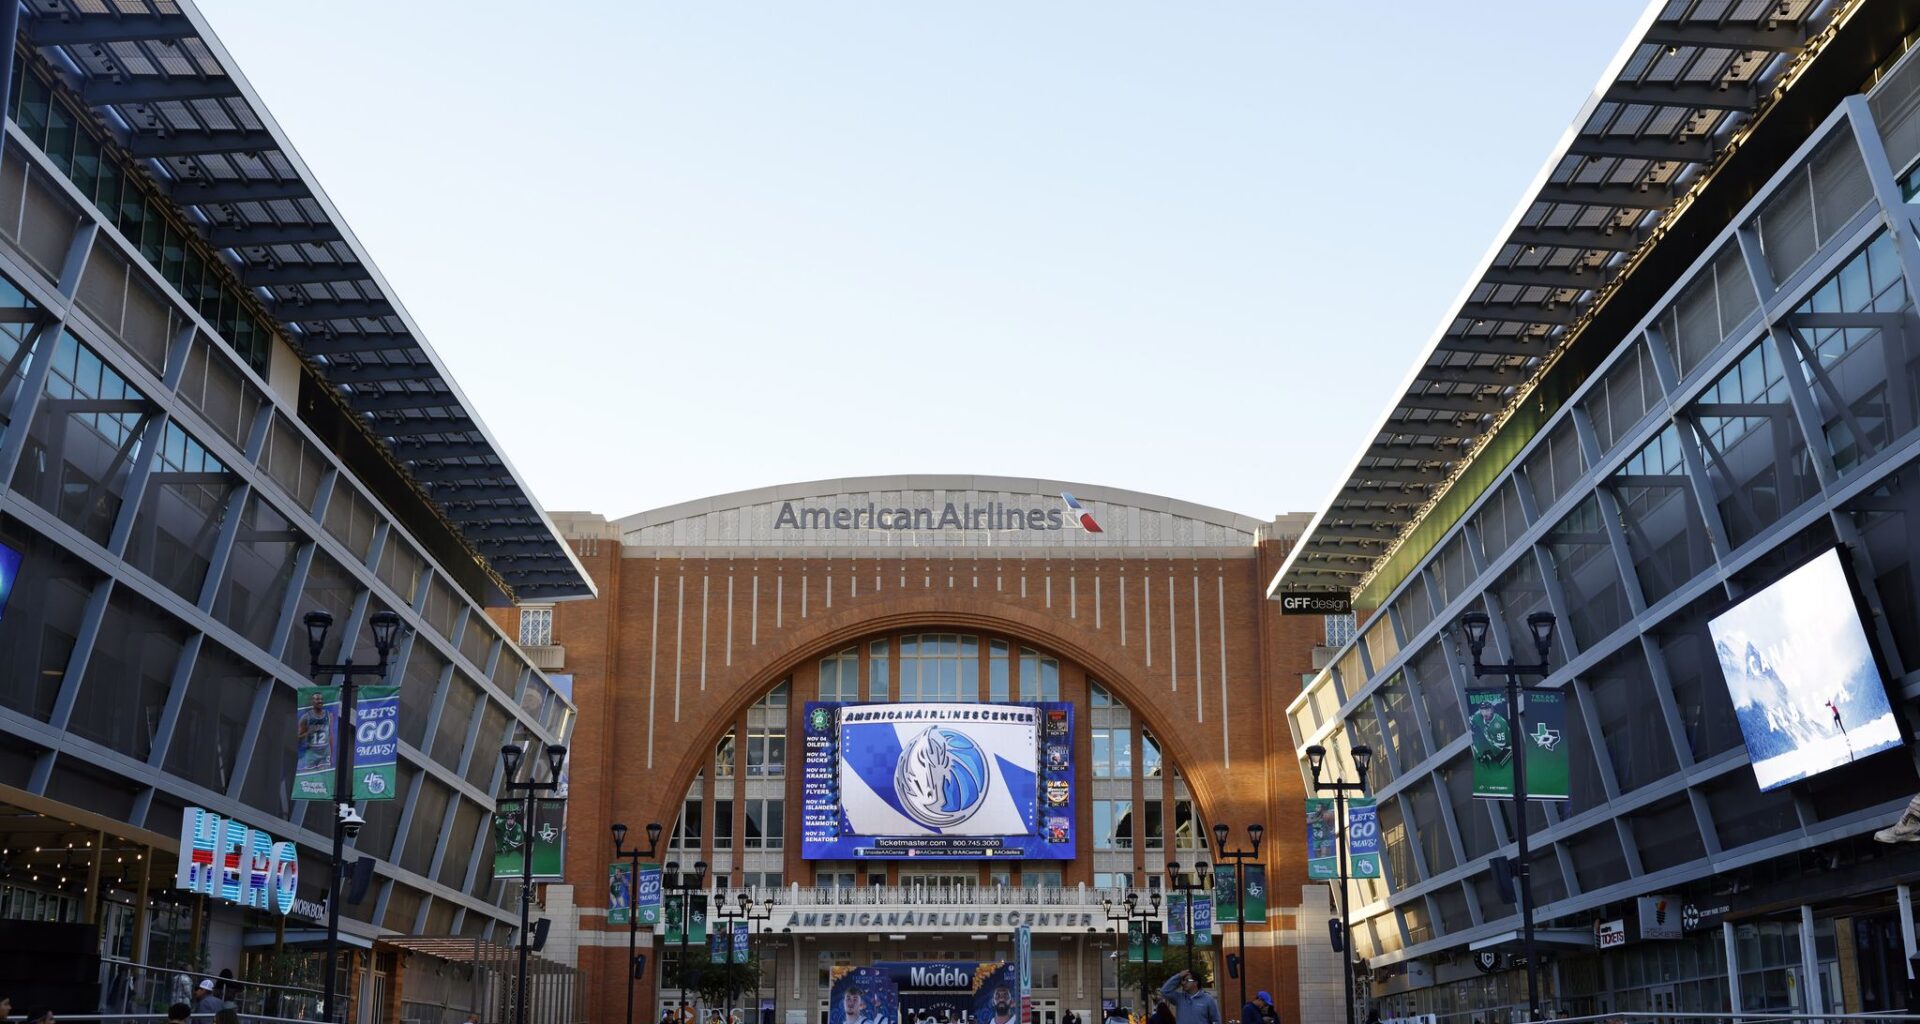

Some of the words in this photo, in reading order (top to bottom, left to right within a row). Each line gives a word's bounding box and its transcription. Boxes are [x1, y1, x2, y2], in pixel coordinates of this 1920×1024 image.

[1284, 597, 1349, 611] GFFdesign
[358, 706, 396, 719] LET'S
[357, 719, 396, 743] GO
[357, 743, 396, 756] MAVS!
[1350, 812, 1375, 822] LET'S
[1351, 822, 1376, 838] GO
[1351, 839, 1377, 848] MAVS!
[178, 807, 299, 915] HERO
[640, 881, 660, 894] GO
[293, 898, 325, 920] WORKBOX
[1194, 910, 1210, 920] GO
[734, 934, 748, 942] GO
[1601, 931, 1624, 945] TICKETS
[911, 967, 969, 987] Modelo
